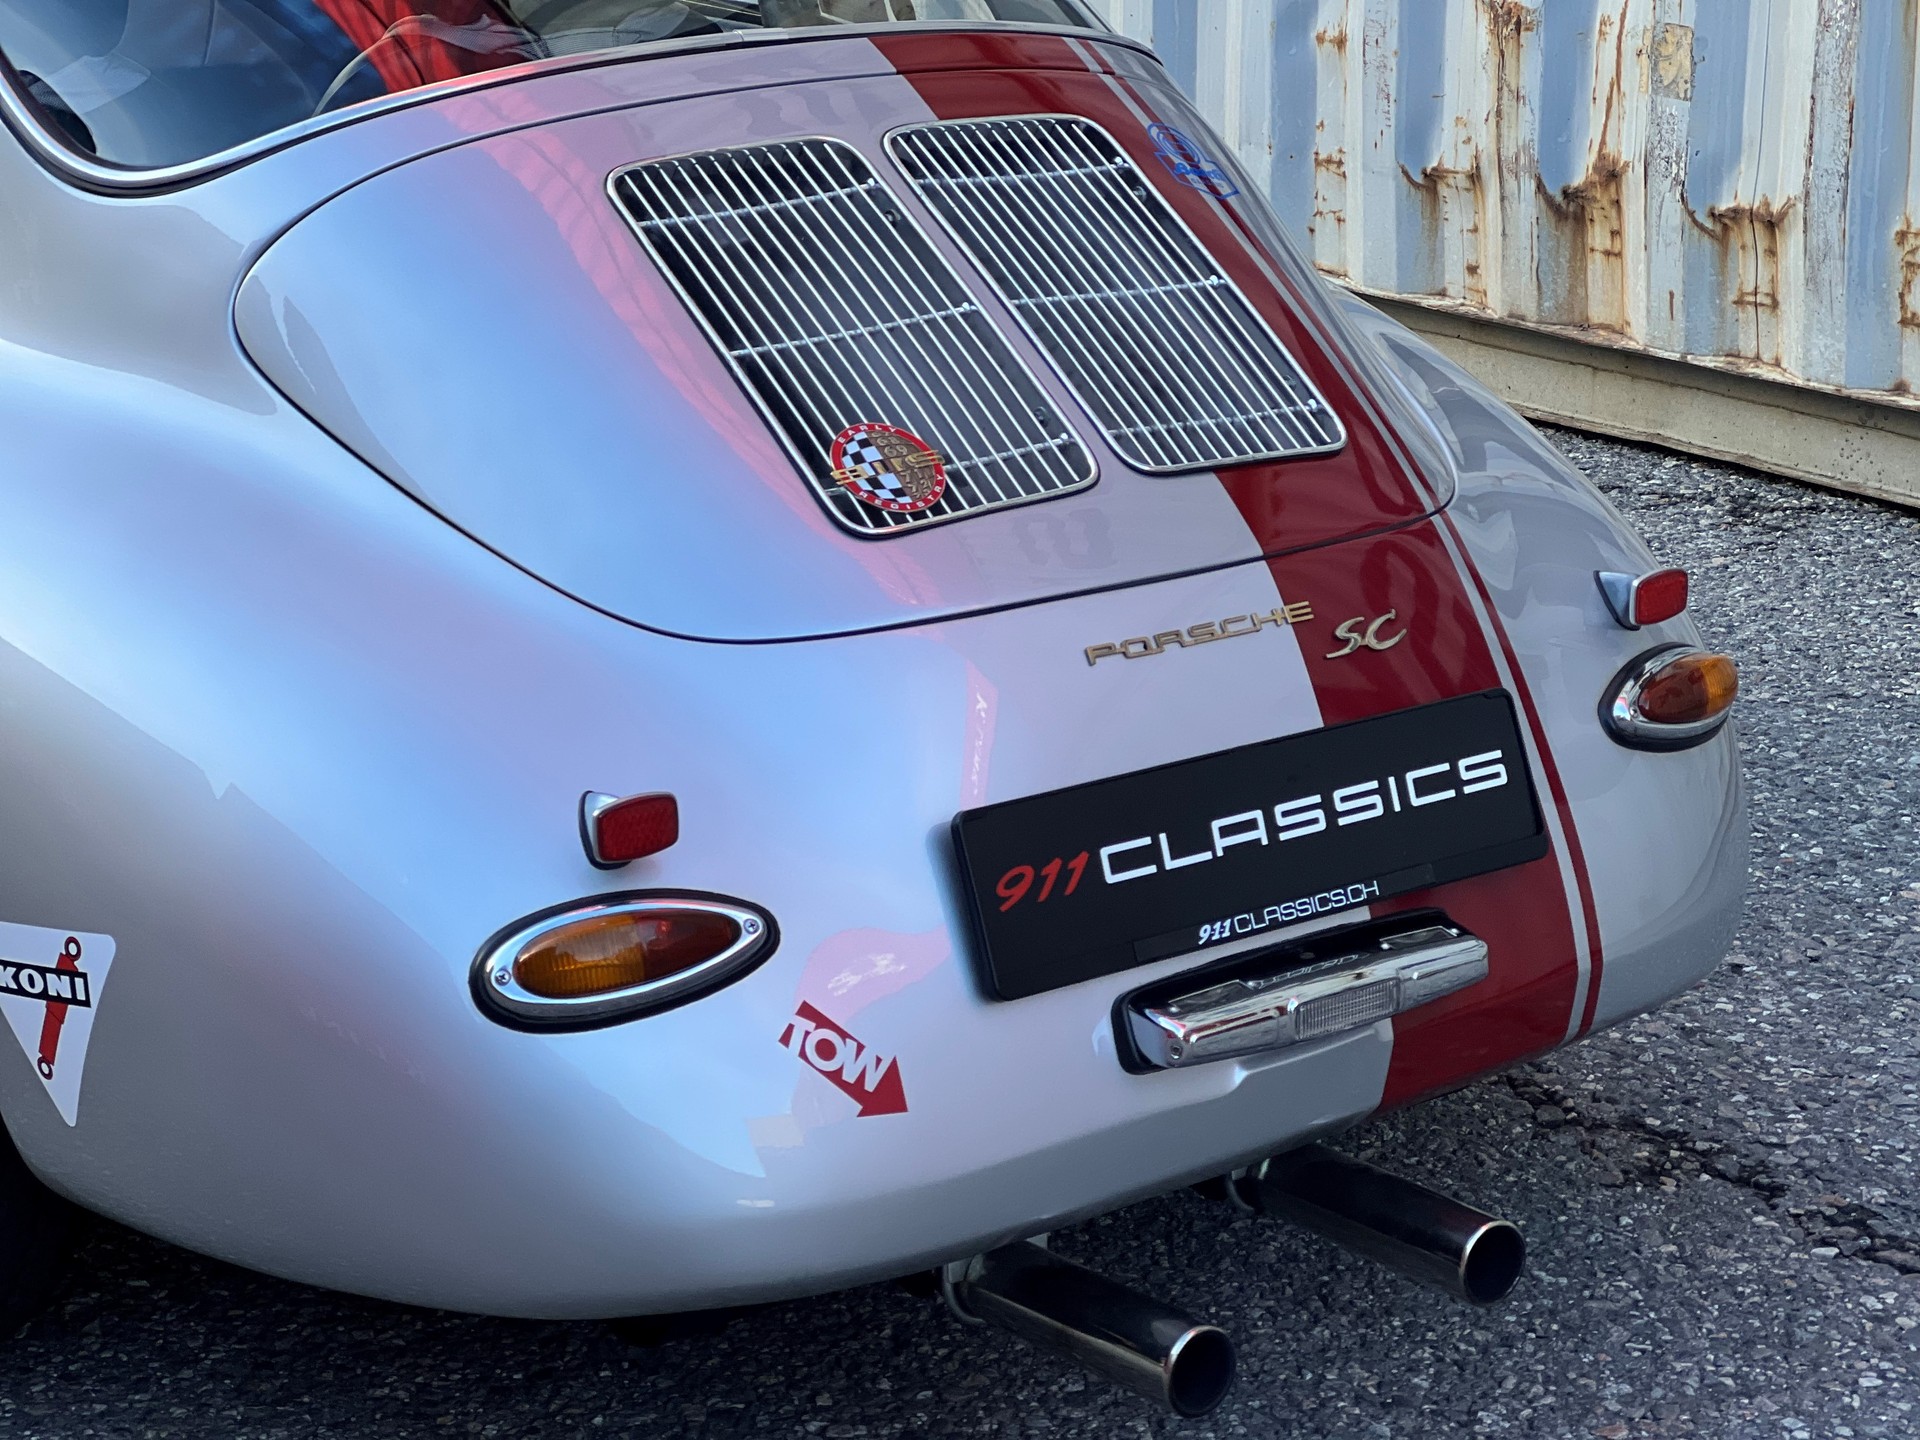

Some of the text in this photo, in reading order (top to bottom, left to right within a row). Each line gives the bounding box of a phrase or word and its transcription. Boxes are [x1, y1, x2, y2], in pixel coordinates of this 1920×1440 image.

[838, 424, 896, 443] EARLY
[858, 473, 945, 510] REGISTRY
[1085, 601, 1408, 666] PORSCHE SC
[0, 964, 86, 1001] KONI
[788, 1013, 896, 1093] TOW
